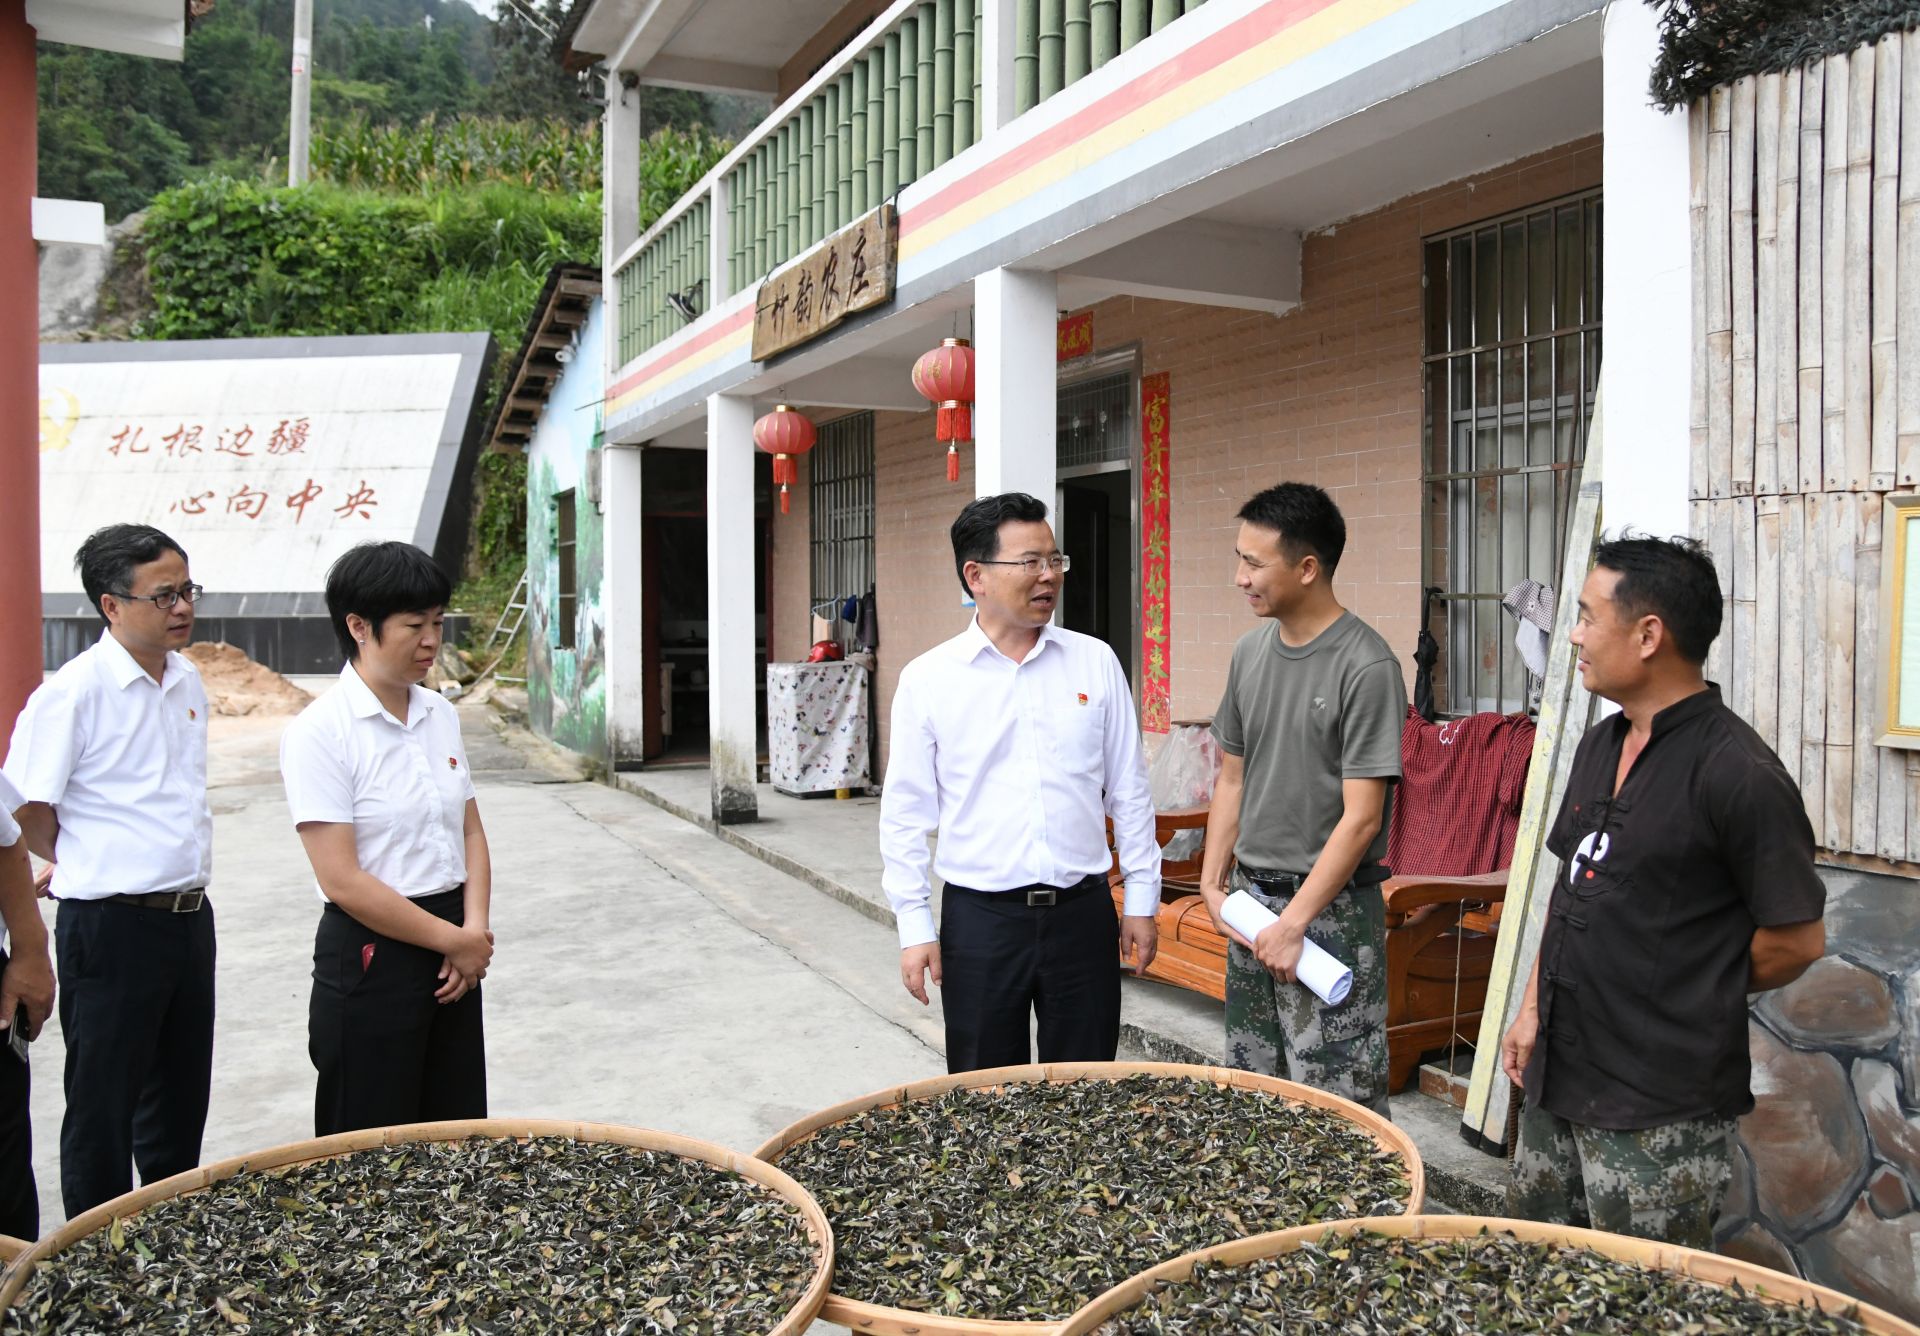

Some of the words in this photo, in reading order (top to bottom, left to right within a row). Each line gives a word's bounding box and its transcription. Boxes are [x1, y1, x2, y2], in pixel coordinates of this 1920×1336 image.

[108, 417, 312, 457] 扎根边疆
[170, 478, 379, 524] 心向中央
